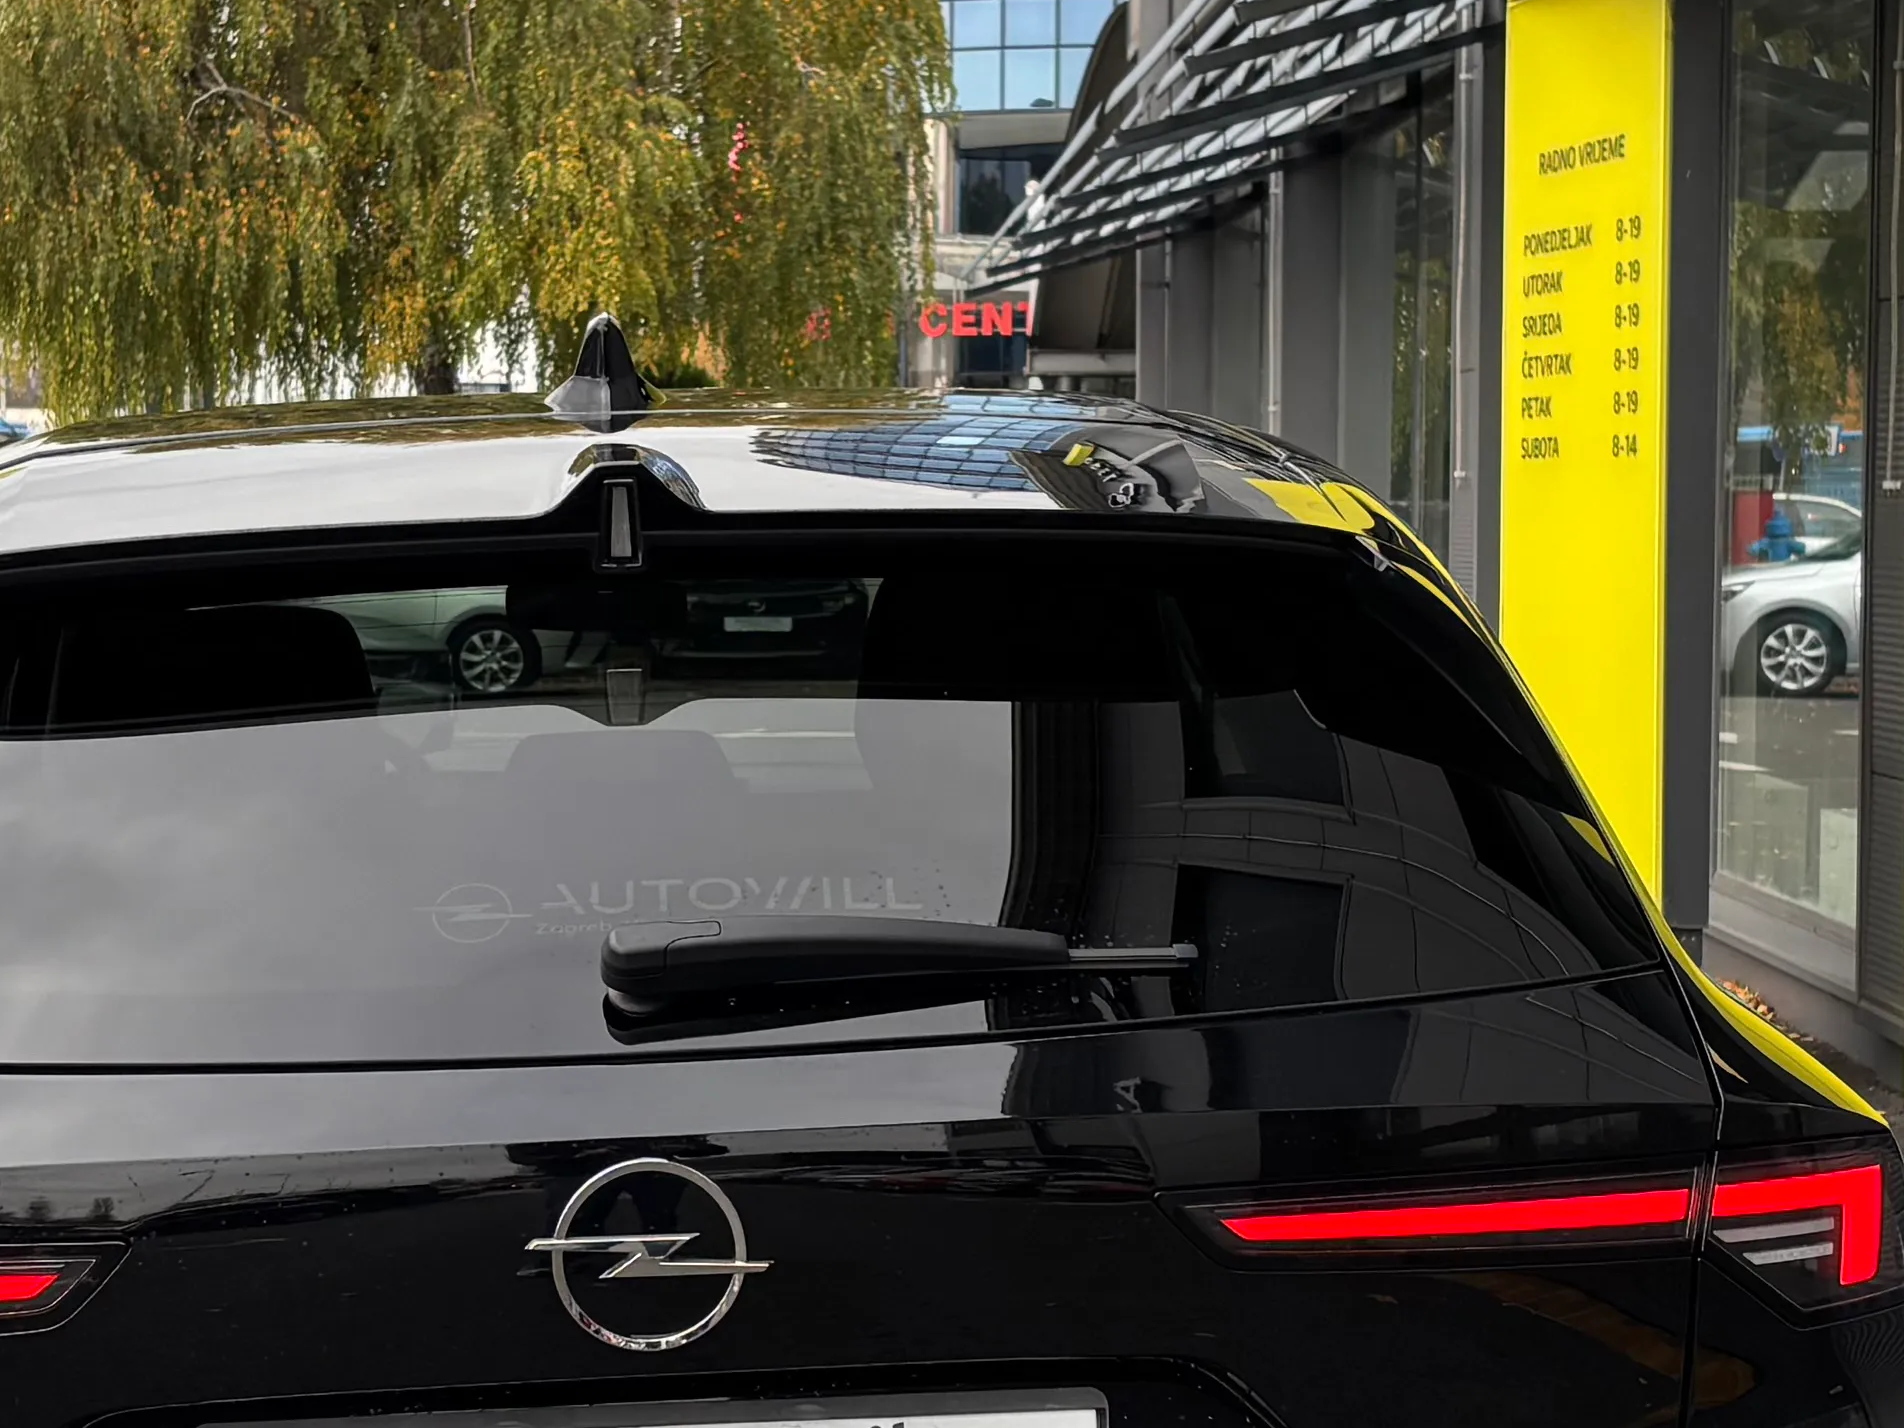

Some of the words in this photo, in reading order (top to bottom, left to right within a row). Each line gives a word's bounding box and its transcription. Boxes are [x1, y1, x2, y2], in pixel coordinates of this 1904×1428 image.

[1538, 145, 1577, 176] RADNO
[1578, 133, 1626, 168] VRIJEME
[1523, 223, 1593, 257] PONEDJELJAK
[1615, 215, 1642, 242] 8-19
[1522, 270, 1563, 298] UTORAK
[1614, 258, 1641, 285] 8-19
[1522, 312, 1563, 338] SRIJEDA
[1614, 303, 1640, 329] 8-19
[1521, 350, 1572, 379] ČETVRTAK
[1613, 346, 1639, 372] 8-19
[1521, 395, 1552, 420] PETAK
[1613, 389, 1638, 415] 8-19
[1521, 436, 1560, 460] SUBOTA
[1612, 433, 1638, 458] 8-14
[539, 875, 925, 916] AUTOWILL
